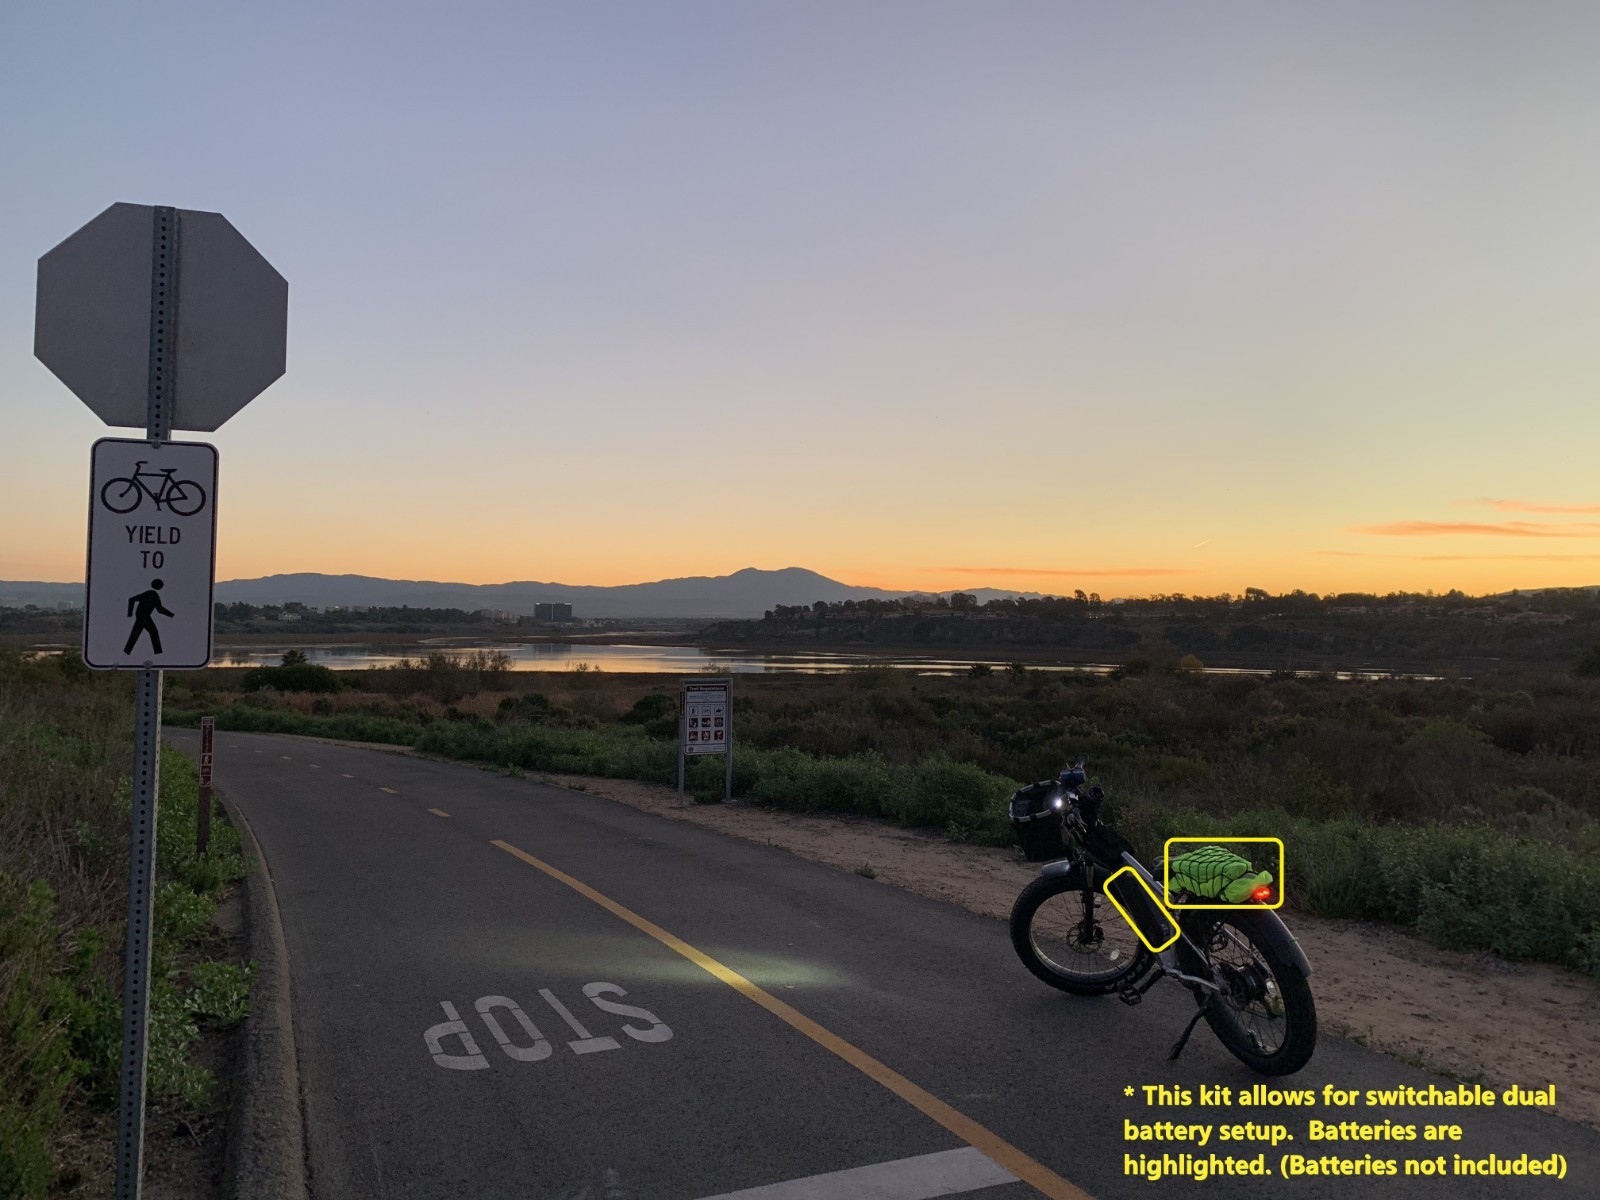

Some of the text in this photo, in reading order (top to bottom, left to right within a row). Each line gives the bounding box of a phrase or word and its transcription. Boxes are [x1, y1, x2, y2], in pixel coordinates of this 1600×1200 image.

[125, 525, 181, 545] YIELD
[140, 550, 164, 569] TO
[423, 981, 674, 1071] STOP
